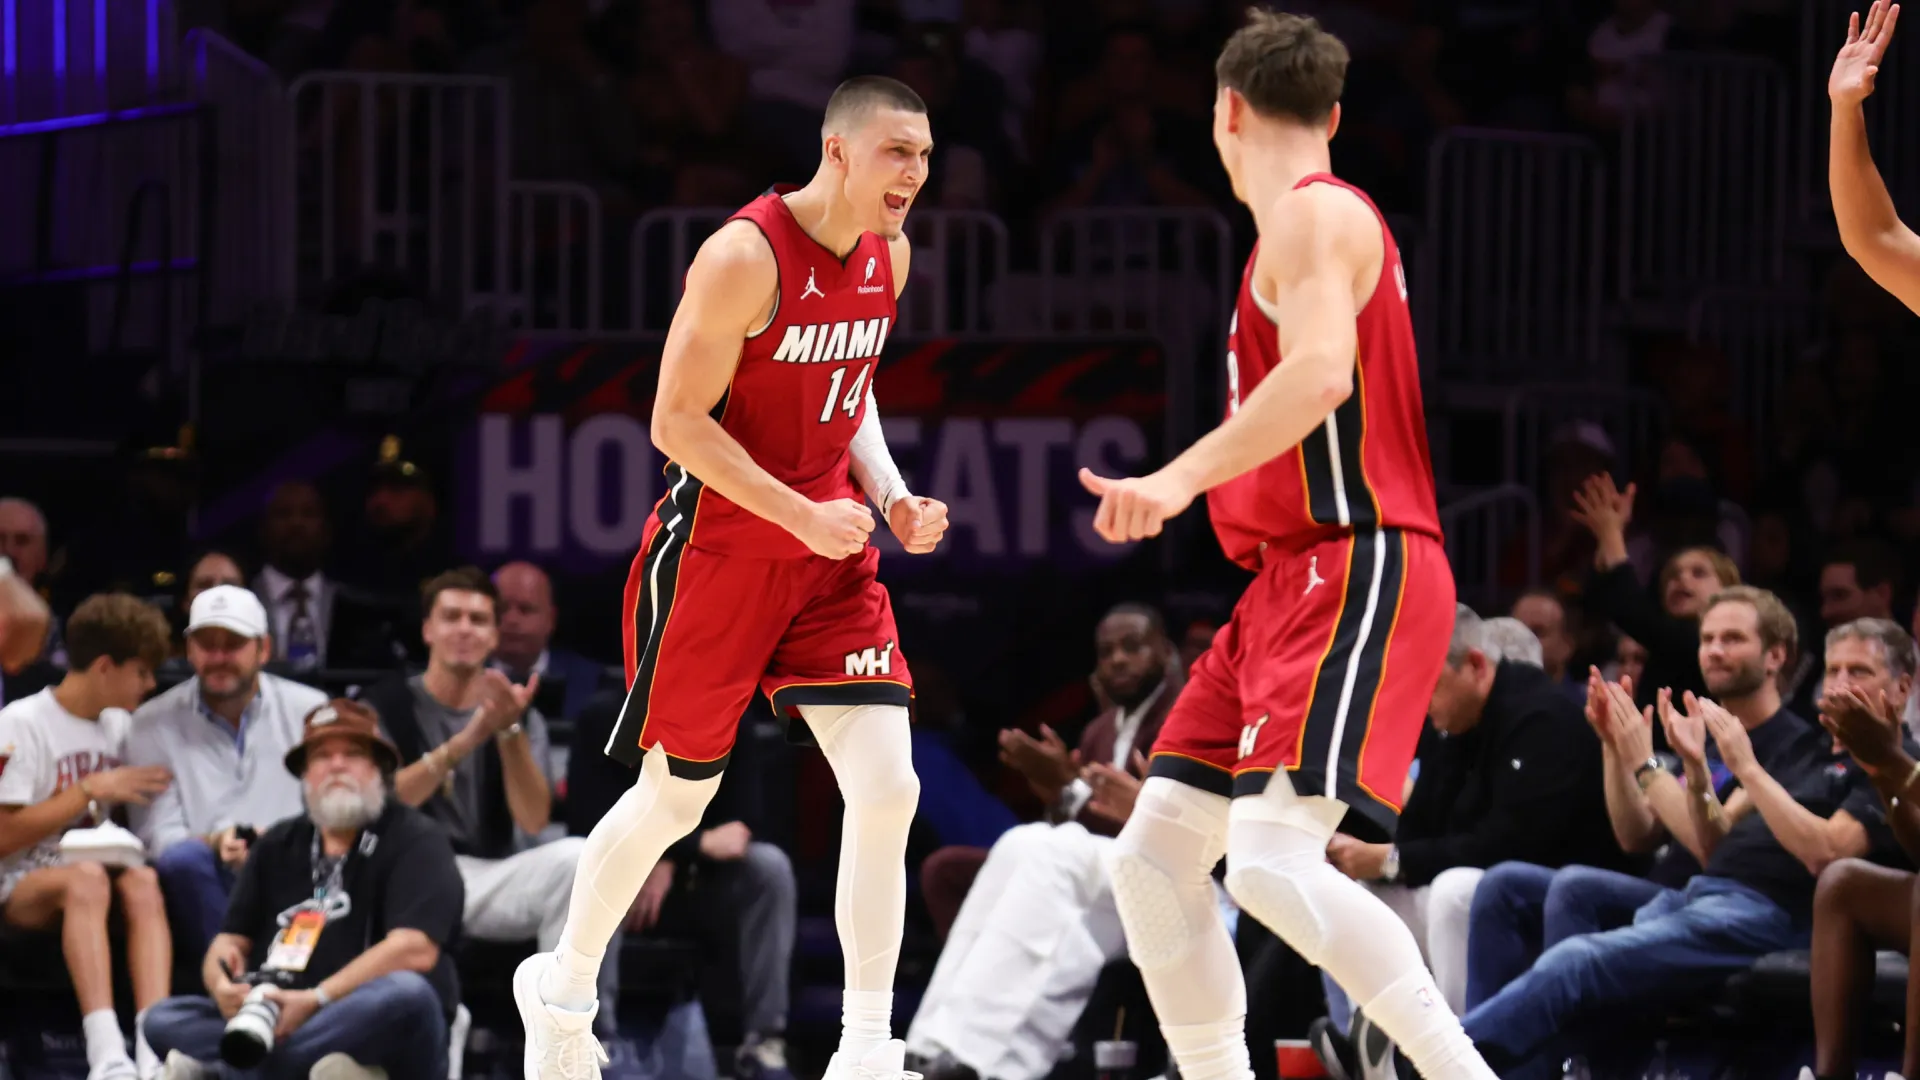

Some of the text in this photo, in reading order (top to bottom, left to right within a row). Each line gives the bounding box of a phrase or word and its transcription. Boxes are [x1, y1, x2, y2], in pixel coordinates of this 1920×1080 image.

[857, 284, 884, 294] Robinhood
[772, 316, 890, 364] MIAMI
[819, 361, 872, 424] 14
[478, 411, 654, 556] HO
